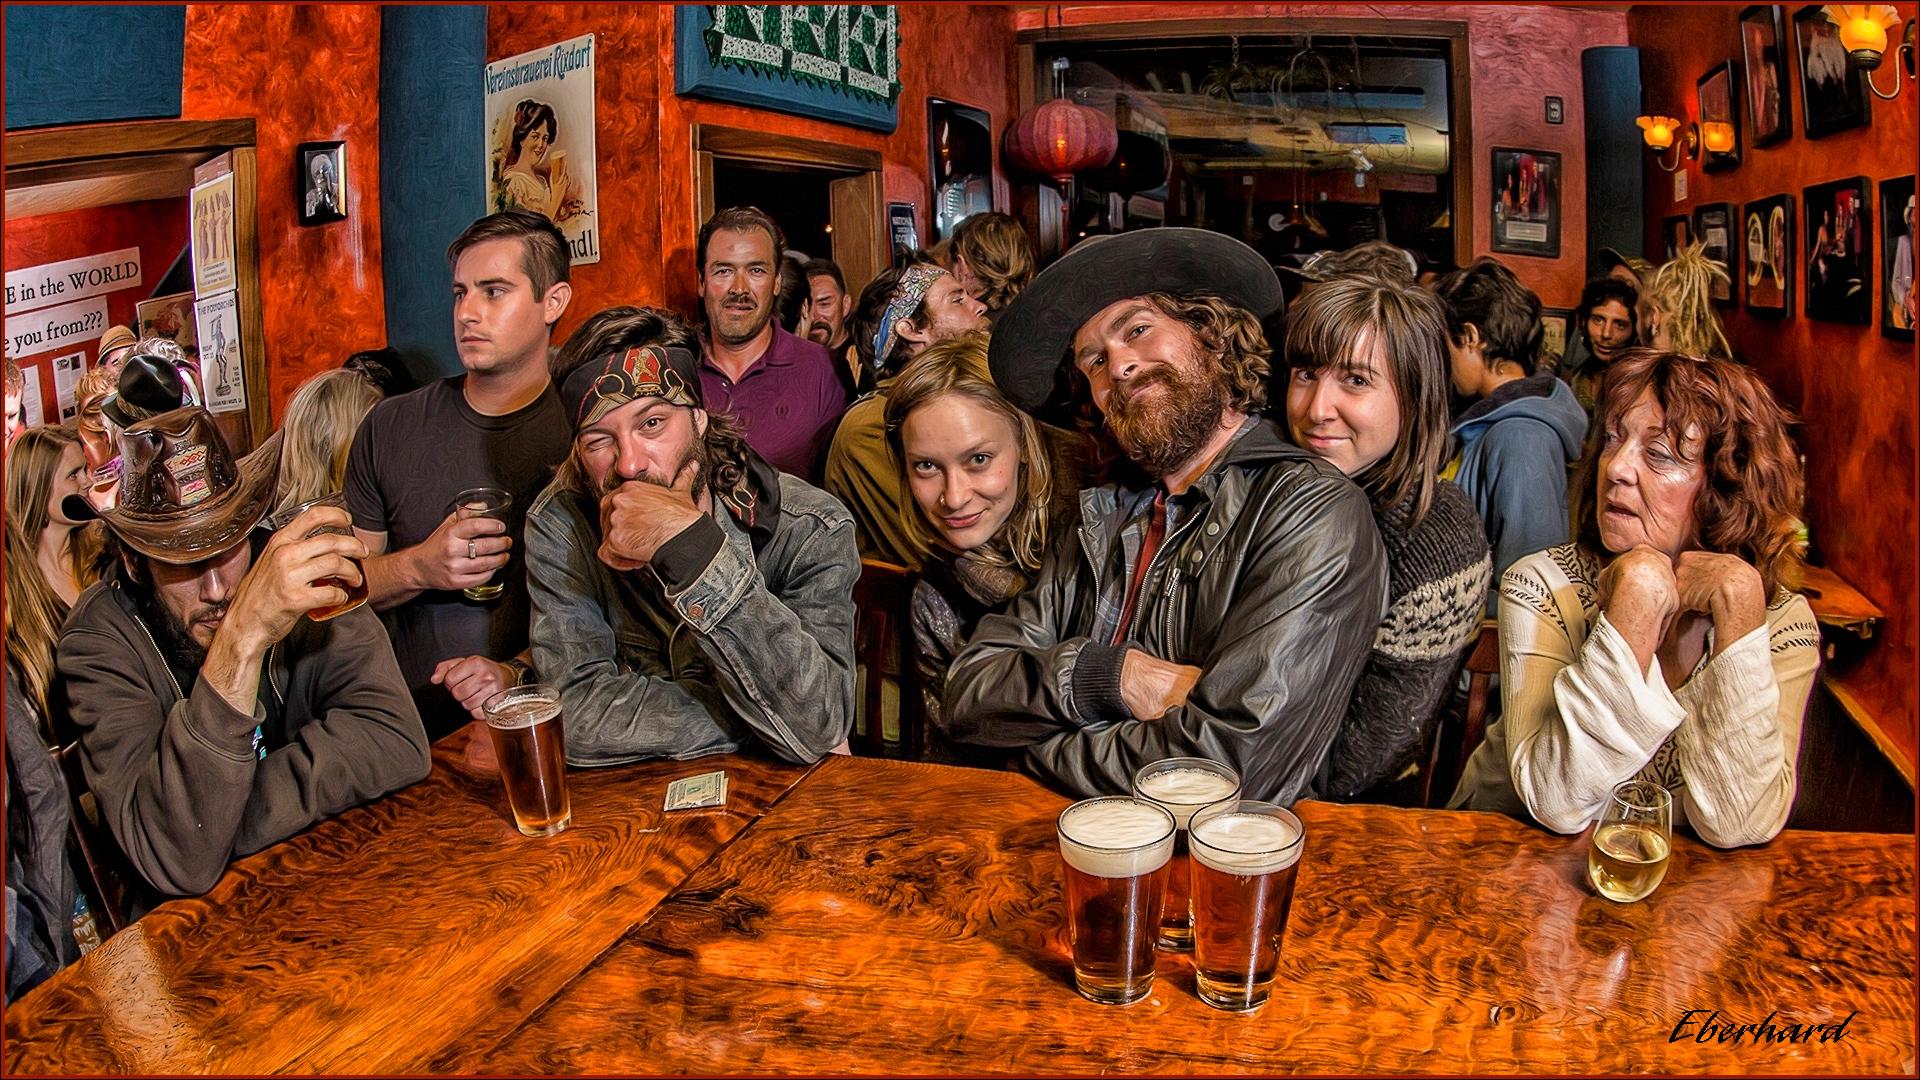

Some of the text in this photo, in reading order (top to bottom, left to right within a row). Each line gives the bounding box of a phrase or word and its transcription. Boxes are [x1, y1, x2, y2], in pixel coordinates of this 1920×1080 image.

[485, 38, 592, 95] Vereinsbrauerei Rixdorf
[568, 229, 598, 258] ndl.
[21, 284, 35, 301] in
[40, 277, 65, 297] the
[68, 261, 139, 290] WORLD
[14, 331, 43, 353] you
[47, 311, 103, 340] from???
